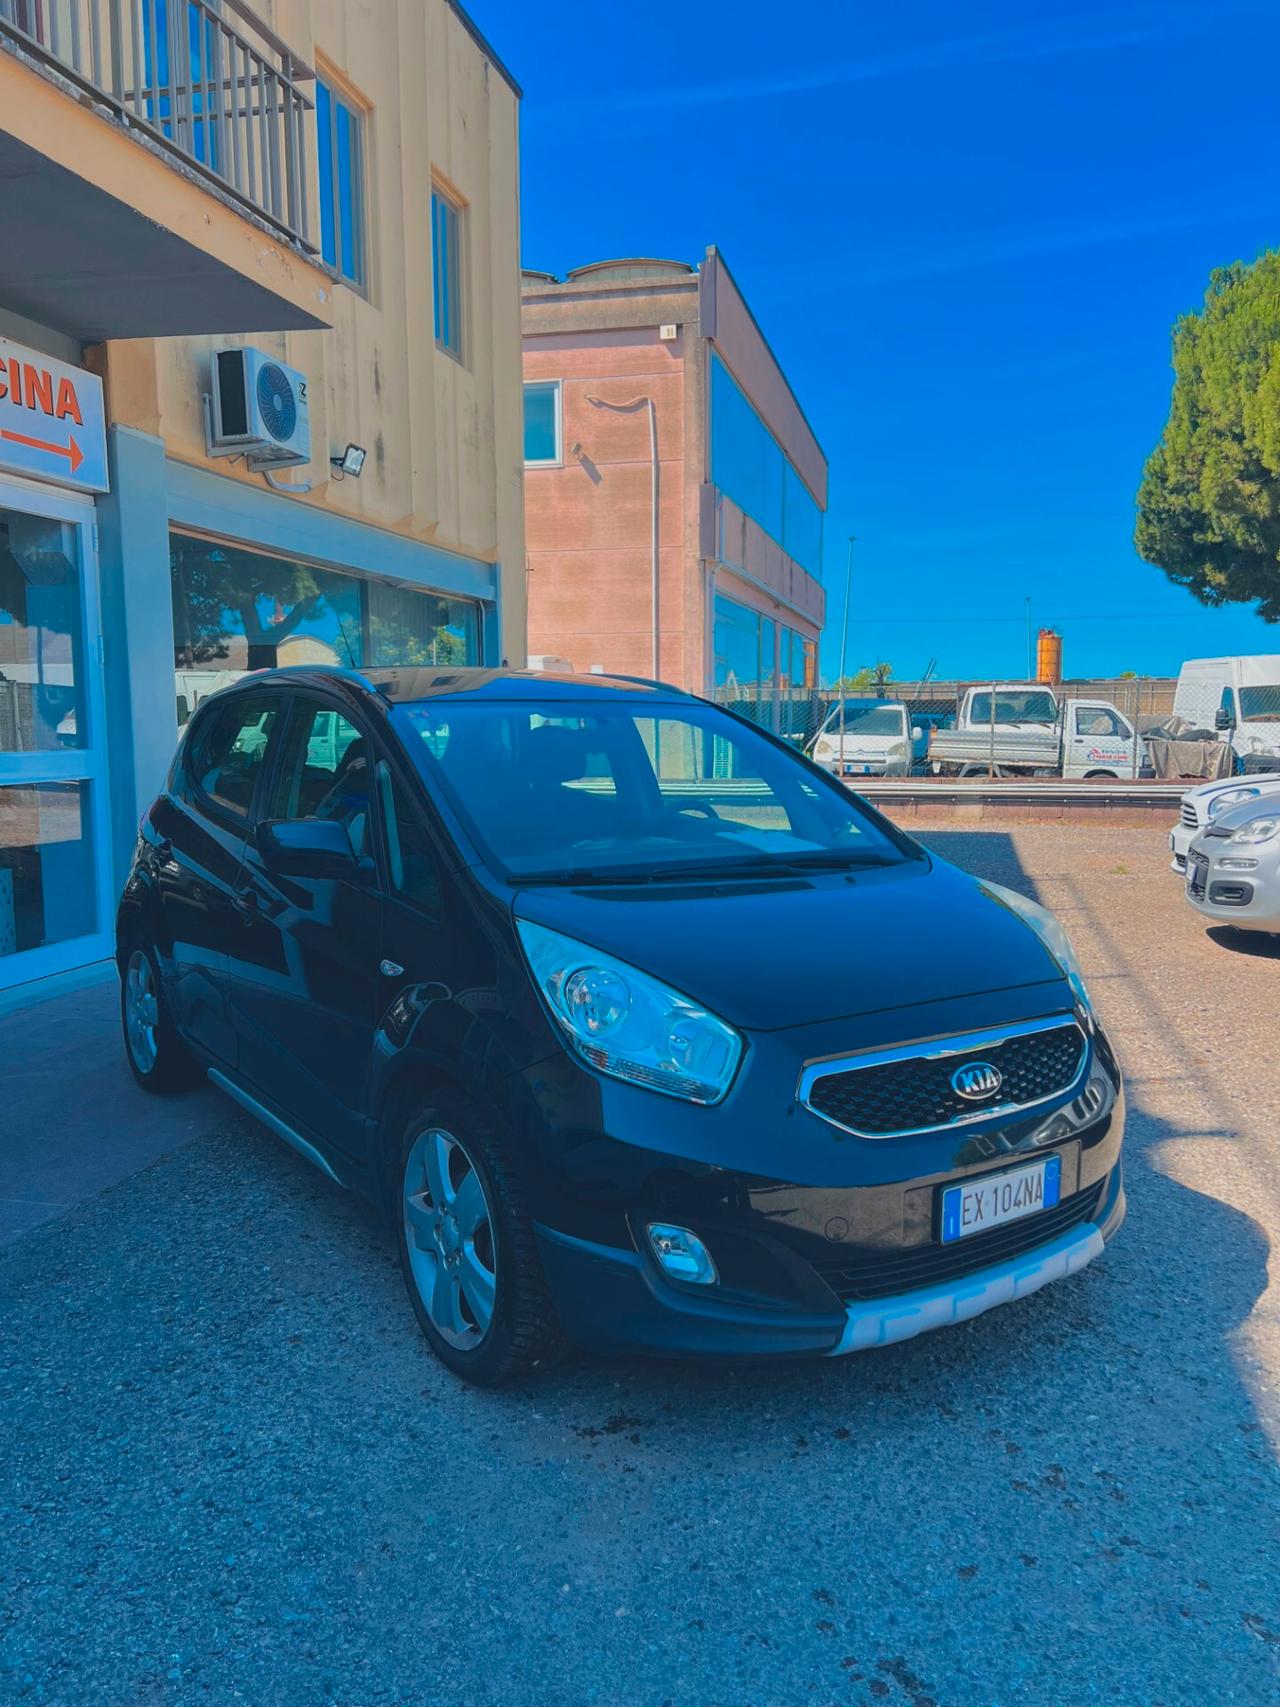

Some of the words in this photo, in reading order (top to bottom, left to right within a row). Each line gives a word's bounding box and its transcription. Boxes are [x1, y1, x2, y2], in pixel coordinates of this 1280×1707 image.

[961, 1067, 999, 1093] KIA
[962, 1191, 984, 1226] EX
[993, 1173, 1043, 1216] 104NA
